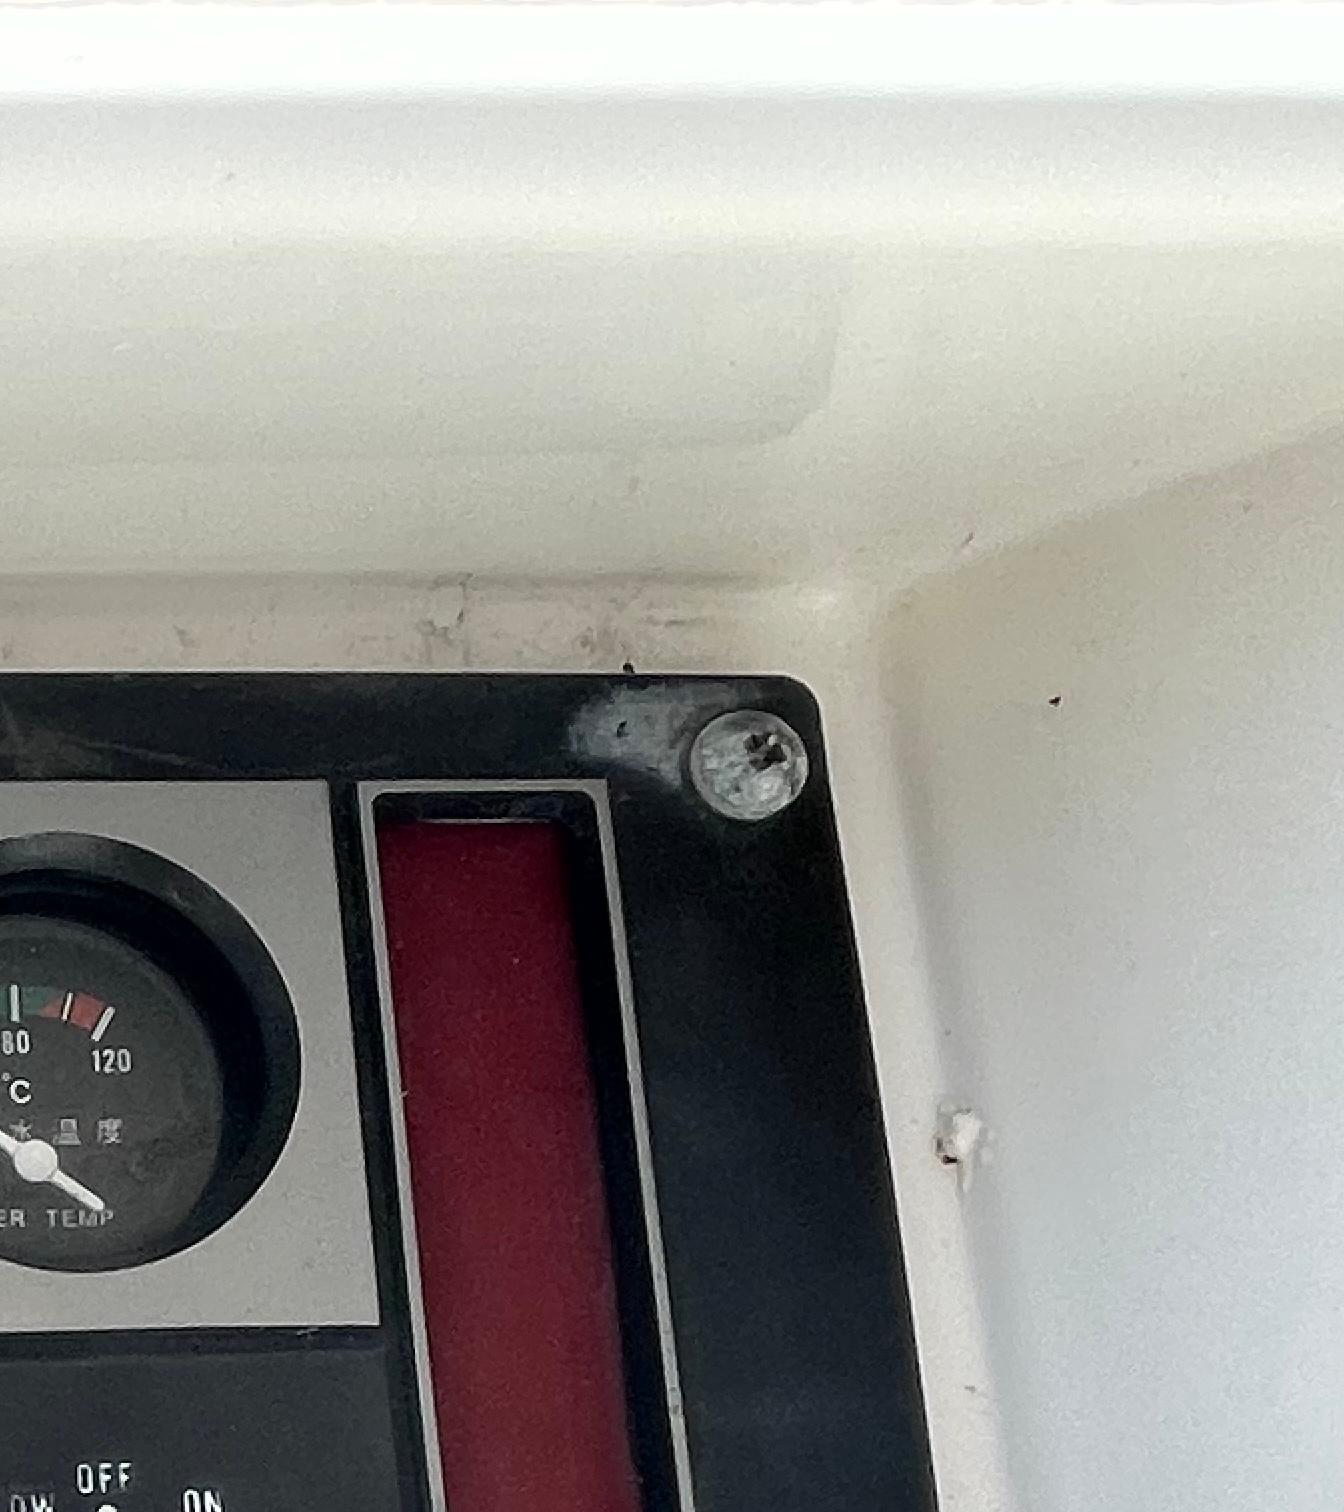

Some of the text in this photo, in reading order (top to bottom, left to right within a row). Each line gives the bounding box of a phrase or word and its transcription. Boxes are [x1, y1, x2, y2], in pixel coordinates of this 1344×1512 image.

[1, 1030, 30, 1055] 80
[92, 1048, 132, 1073] 120
[46, 1209, 113, 1228] TEMP
[76, 1463, 132, 1494] OFF
